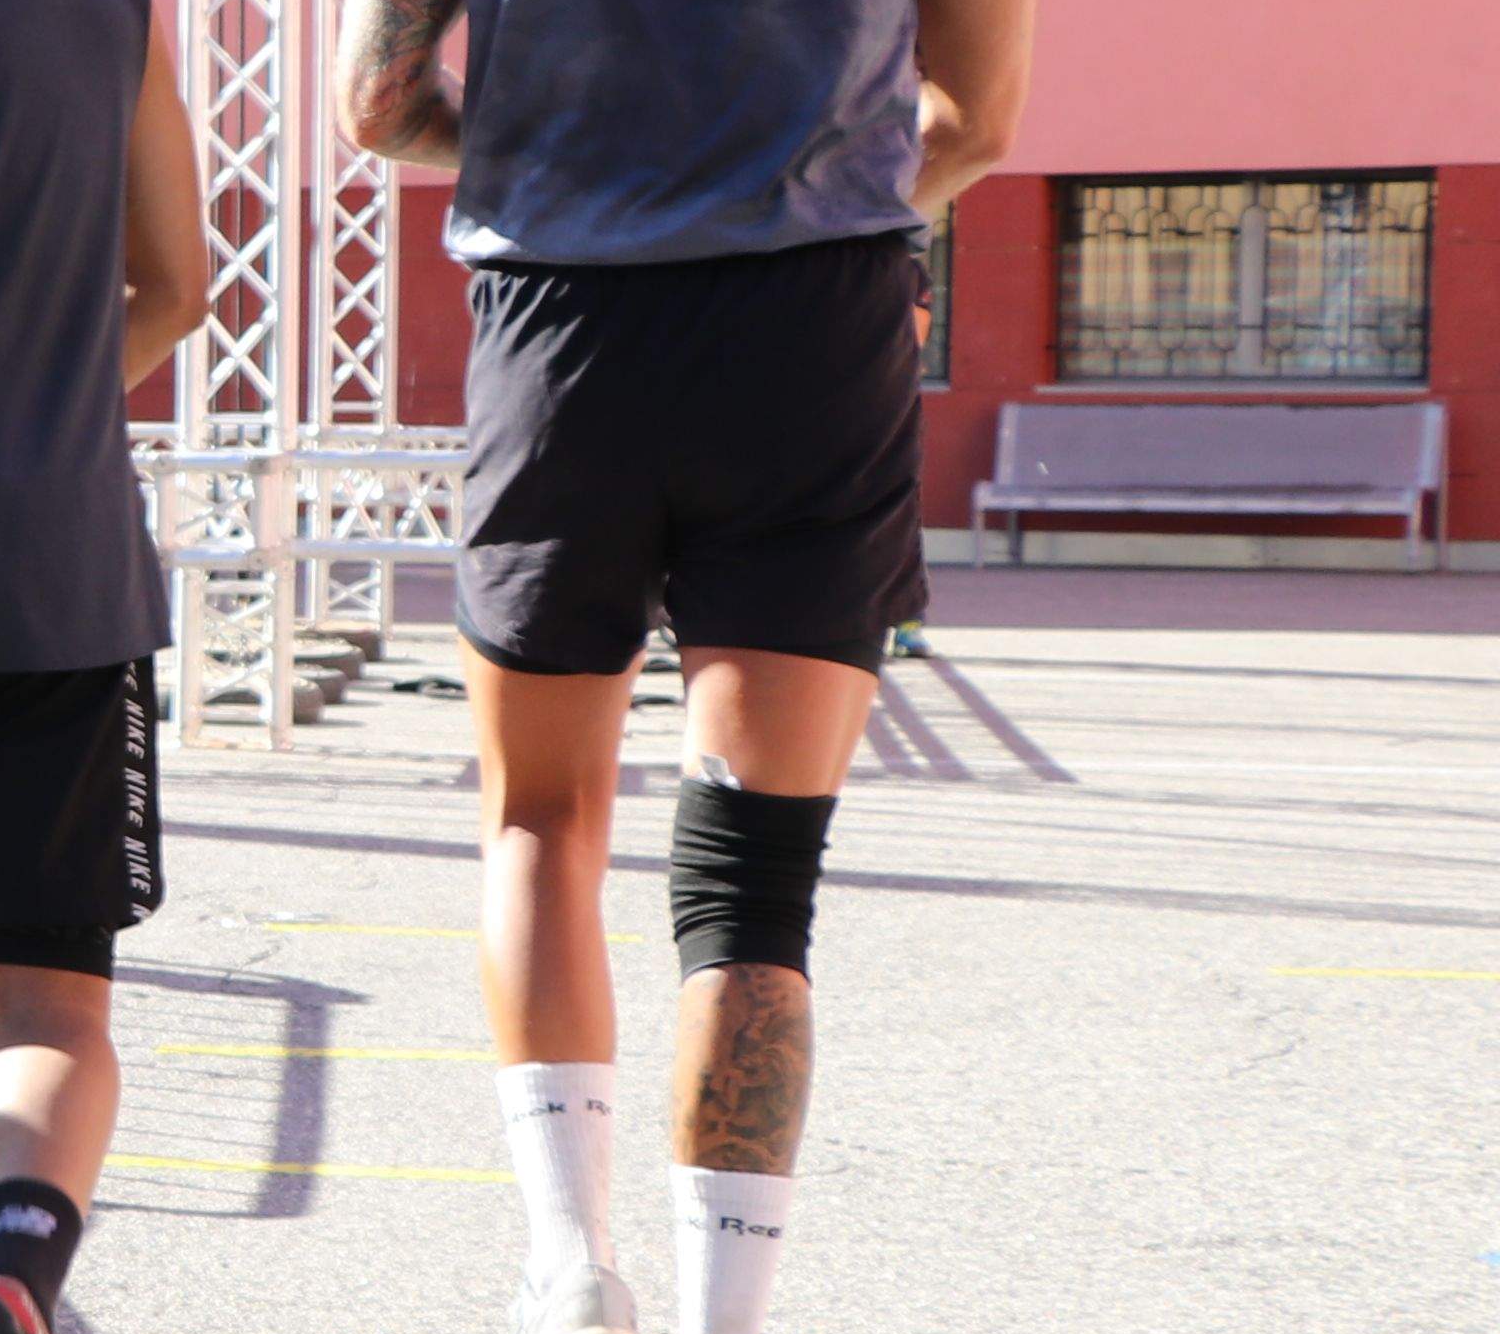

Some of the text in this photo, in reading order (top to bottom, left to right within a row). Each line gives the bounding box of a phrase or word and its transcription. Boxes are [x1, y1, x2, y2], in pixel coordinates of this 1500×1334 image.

[124, 698, 146, 760] NIKE
[124, 767, 148, 829] NIKE
[124, 836, 152, 896] NIKE
